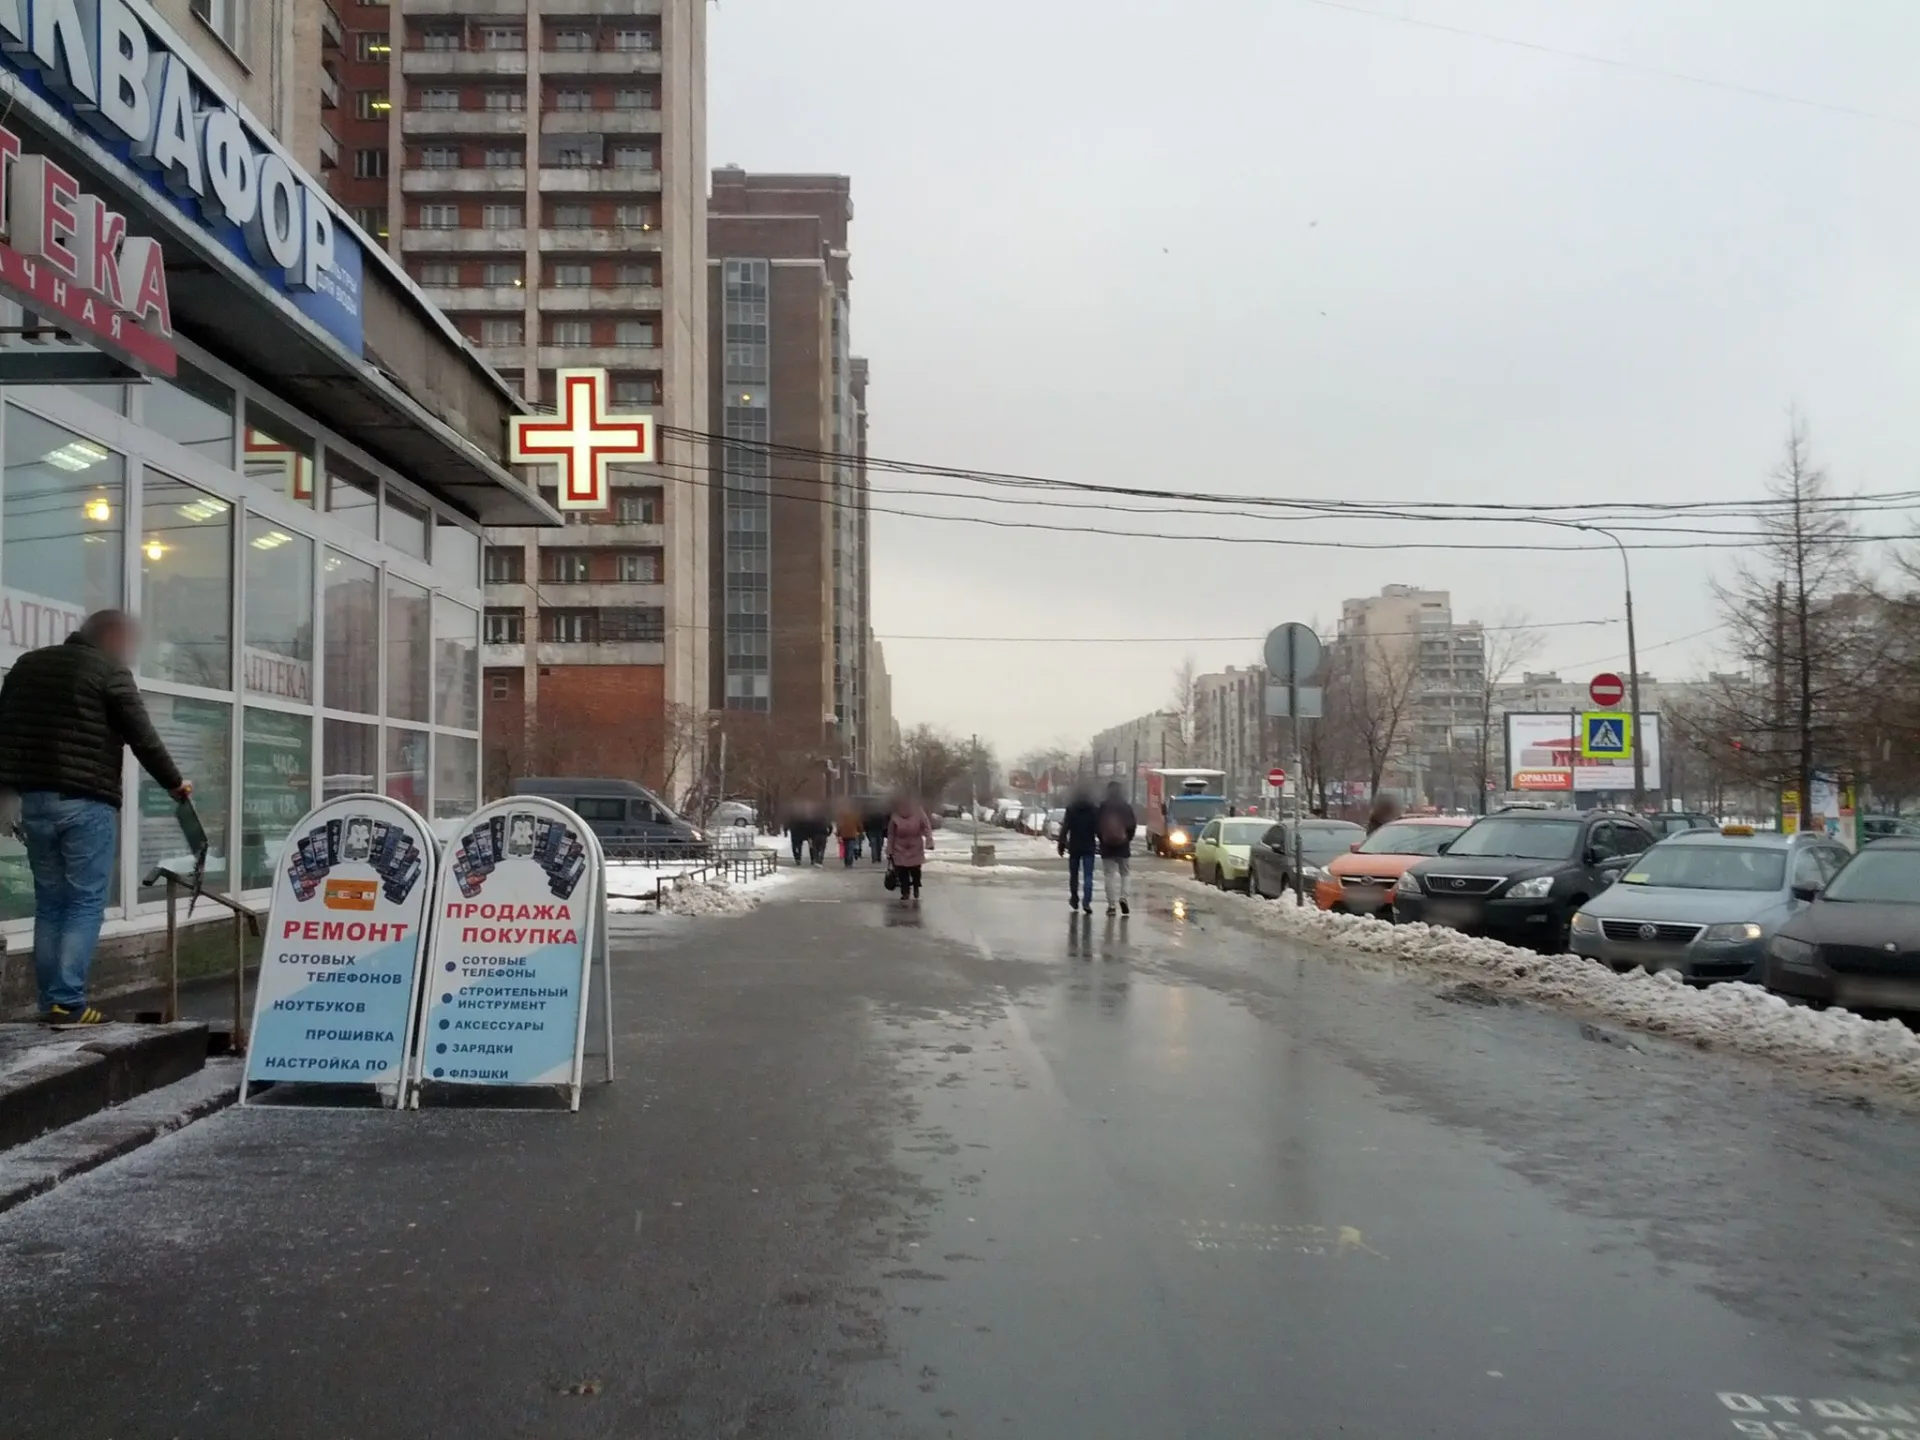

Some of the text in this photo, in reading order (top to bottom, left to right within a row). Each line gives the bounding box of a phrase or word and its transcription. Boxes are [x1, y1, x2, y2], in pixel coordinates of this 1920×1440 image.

[1518, 773, 1566, 782] ОРМАТЕК
[446, 903, 571, 922] ПРОДАЖА
[283, 920, 408, 942] РЕМОНТ
[462, 927, 578, 945] ПОКУПКА
[279, 953, 356, 966] СОТОВЫХ
[462, 956, 527, 966] СОТОВЫЕ
[307, 971, 402, 985] ТЕЛЕФОНОВ
[461, 968, 536, 979] ТЕЛЕФОНЫ
[459, 986, 568, 998] СТРОИТЕЛЬНЫЙ
[273, 1000, 366, 1013] НОУТБУКОВ
[457, 1000, 547, 1011] ИНСТРУМЕНТ
[455, 1020, 544, 1032] АКСЕССУАРЫ
[305, 1029, 395, 1043] ПРОШИВКА
[452, 1043, 513, 1055] ЗАРЯДКИ
[265, 1056, 388, 1072] НАСТРОЙКА ПО
[449, 1069, 509, 1080] ФЛЭШКИ
